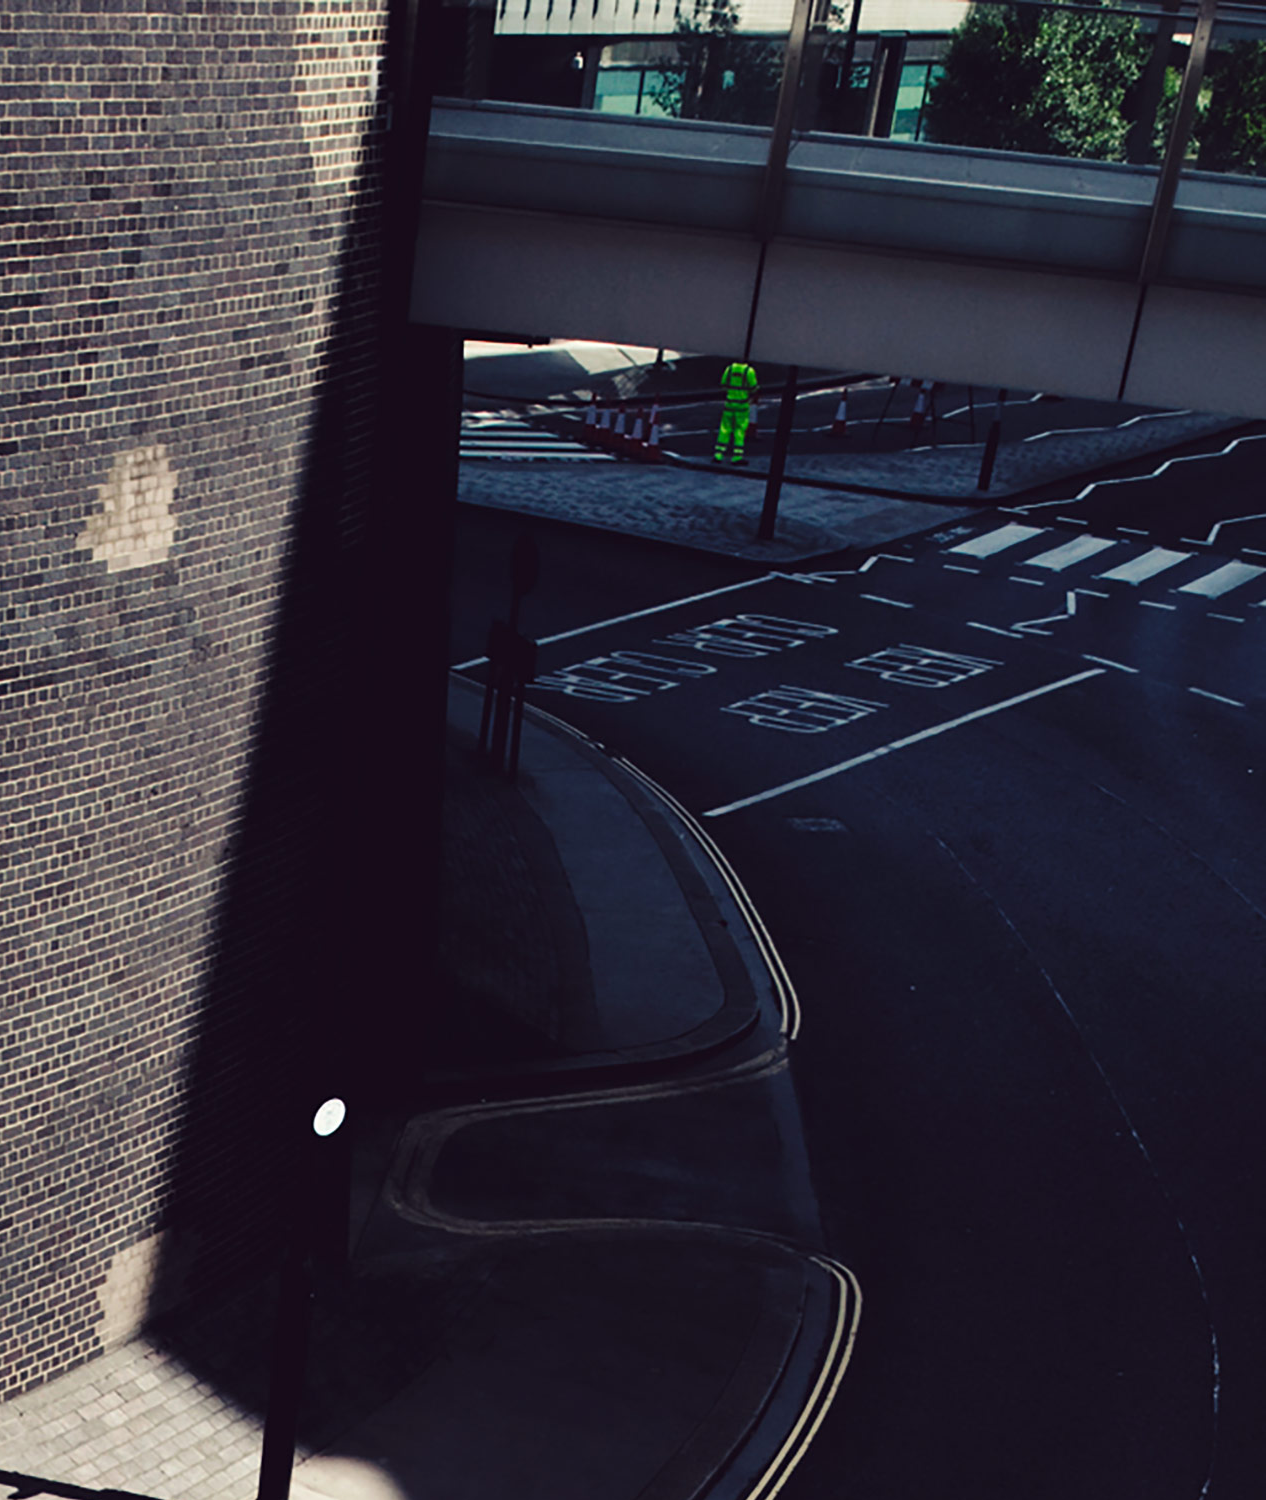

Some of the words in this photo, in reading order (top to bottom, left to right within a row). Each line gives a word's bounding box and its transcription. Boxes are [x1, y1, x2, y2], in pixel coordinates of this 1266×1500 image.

[652, 613, 839, 659] CLEAR
[843, 642, 1005, 688] KEEP
[719, 684, 891, 734] KEEP
